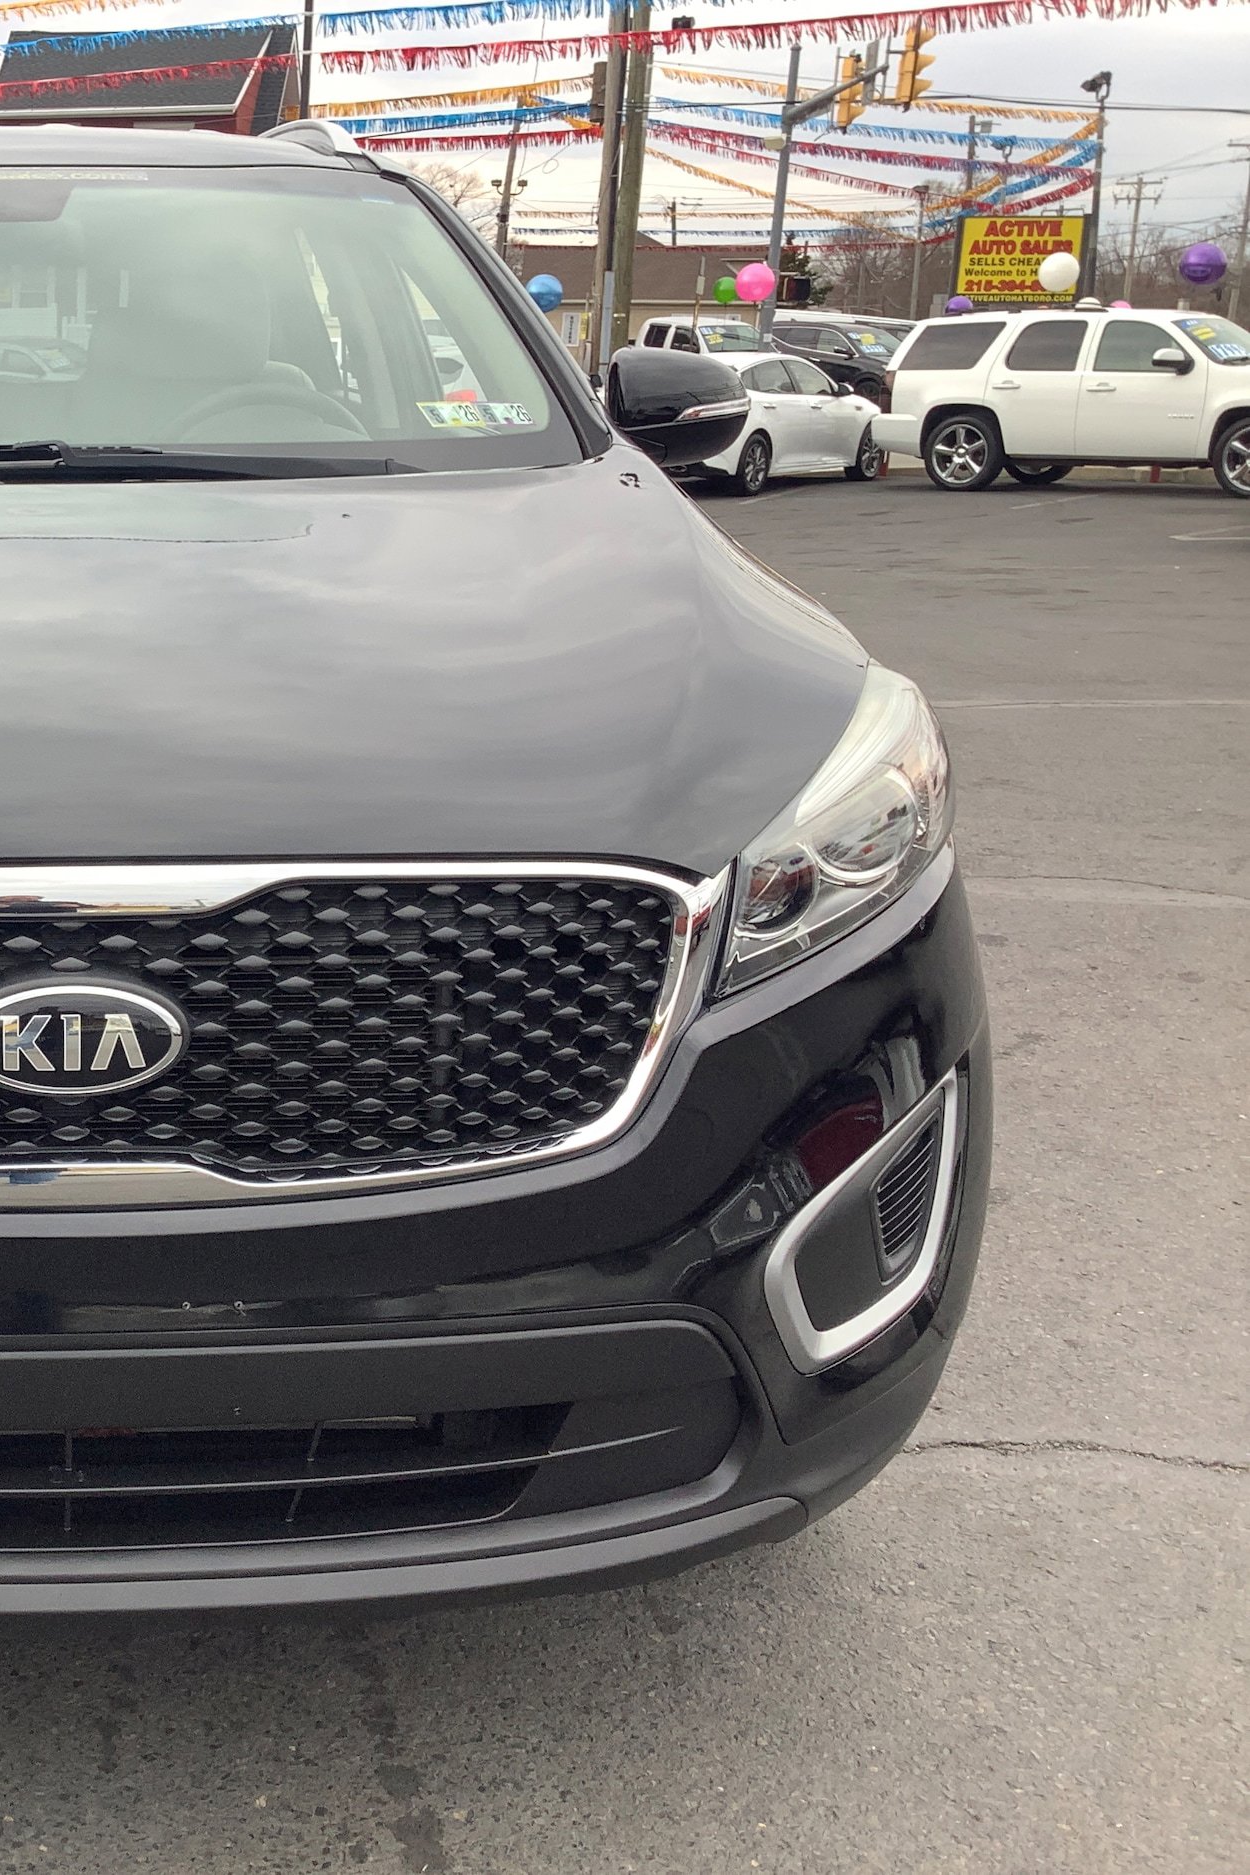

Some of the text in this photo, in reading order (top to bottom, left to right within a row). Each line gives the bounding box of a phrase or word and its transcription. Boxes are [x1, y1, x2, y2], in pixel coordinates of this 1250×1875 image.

[984, 220, 1063, 237] ACTIVE
[969, 240, 1073, 255] AUTO SALES
[969, 257, 1046, 266] SELLS CHEA
[964, 268, 1013, 277] Welcome
[1016, 268, 1027, 277] to
[458, 404, 480, 422] 26
[510, 404, 532, 422] 26
[0, 1013, 147, 1072] KIA
